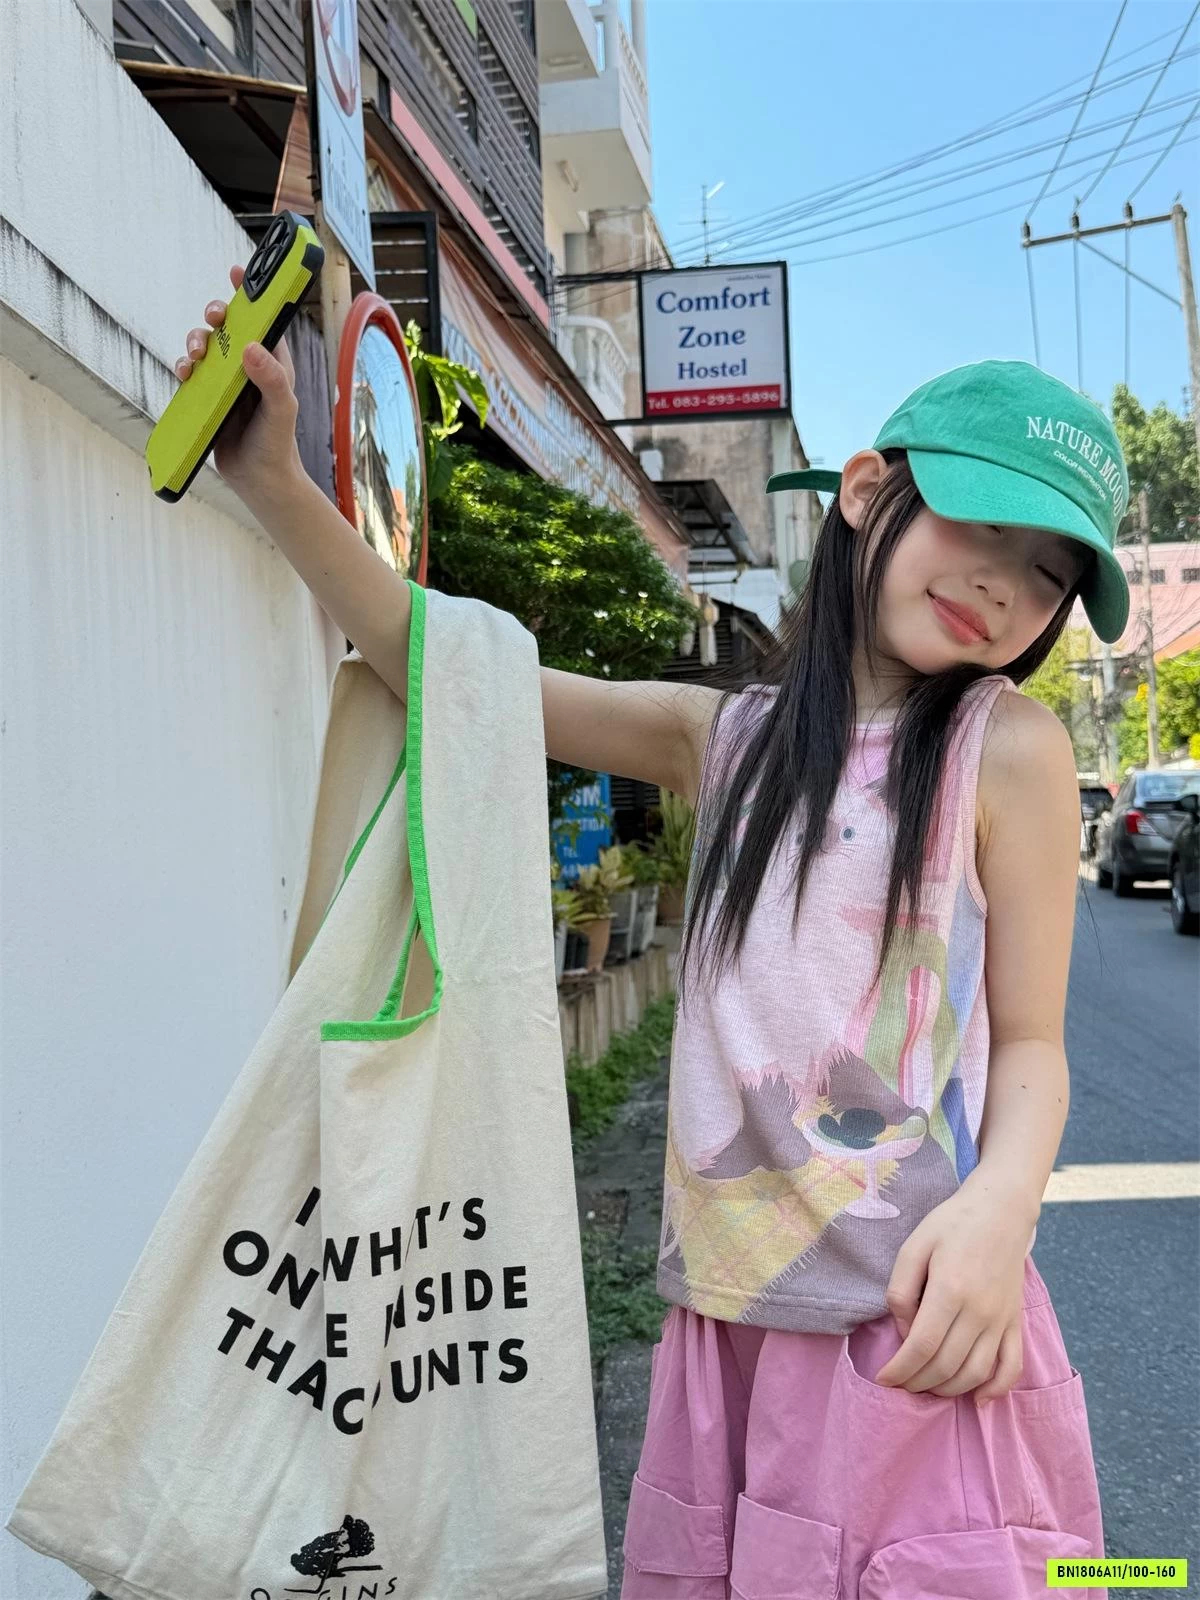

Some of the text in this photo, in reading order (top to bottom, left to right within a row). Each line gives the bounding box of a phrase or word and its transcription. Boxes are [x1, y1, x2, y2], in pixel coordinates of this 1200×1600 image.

[656, 286, 771, 314] Comfort
[678, 326, 746, 349] Zone
[677, 358, 747, 381] Hostel
[648, 398, 669, 410] Tel.
[1026, 416, 1103, 468] NATURE
